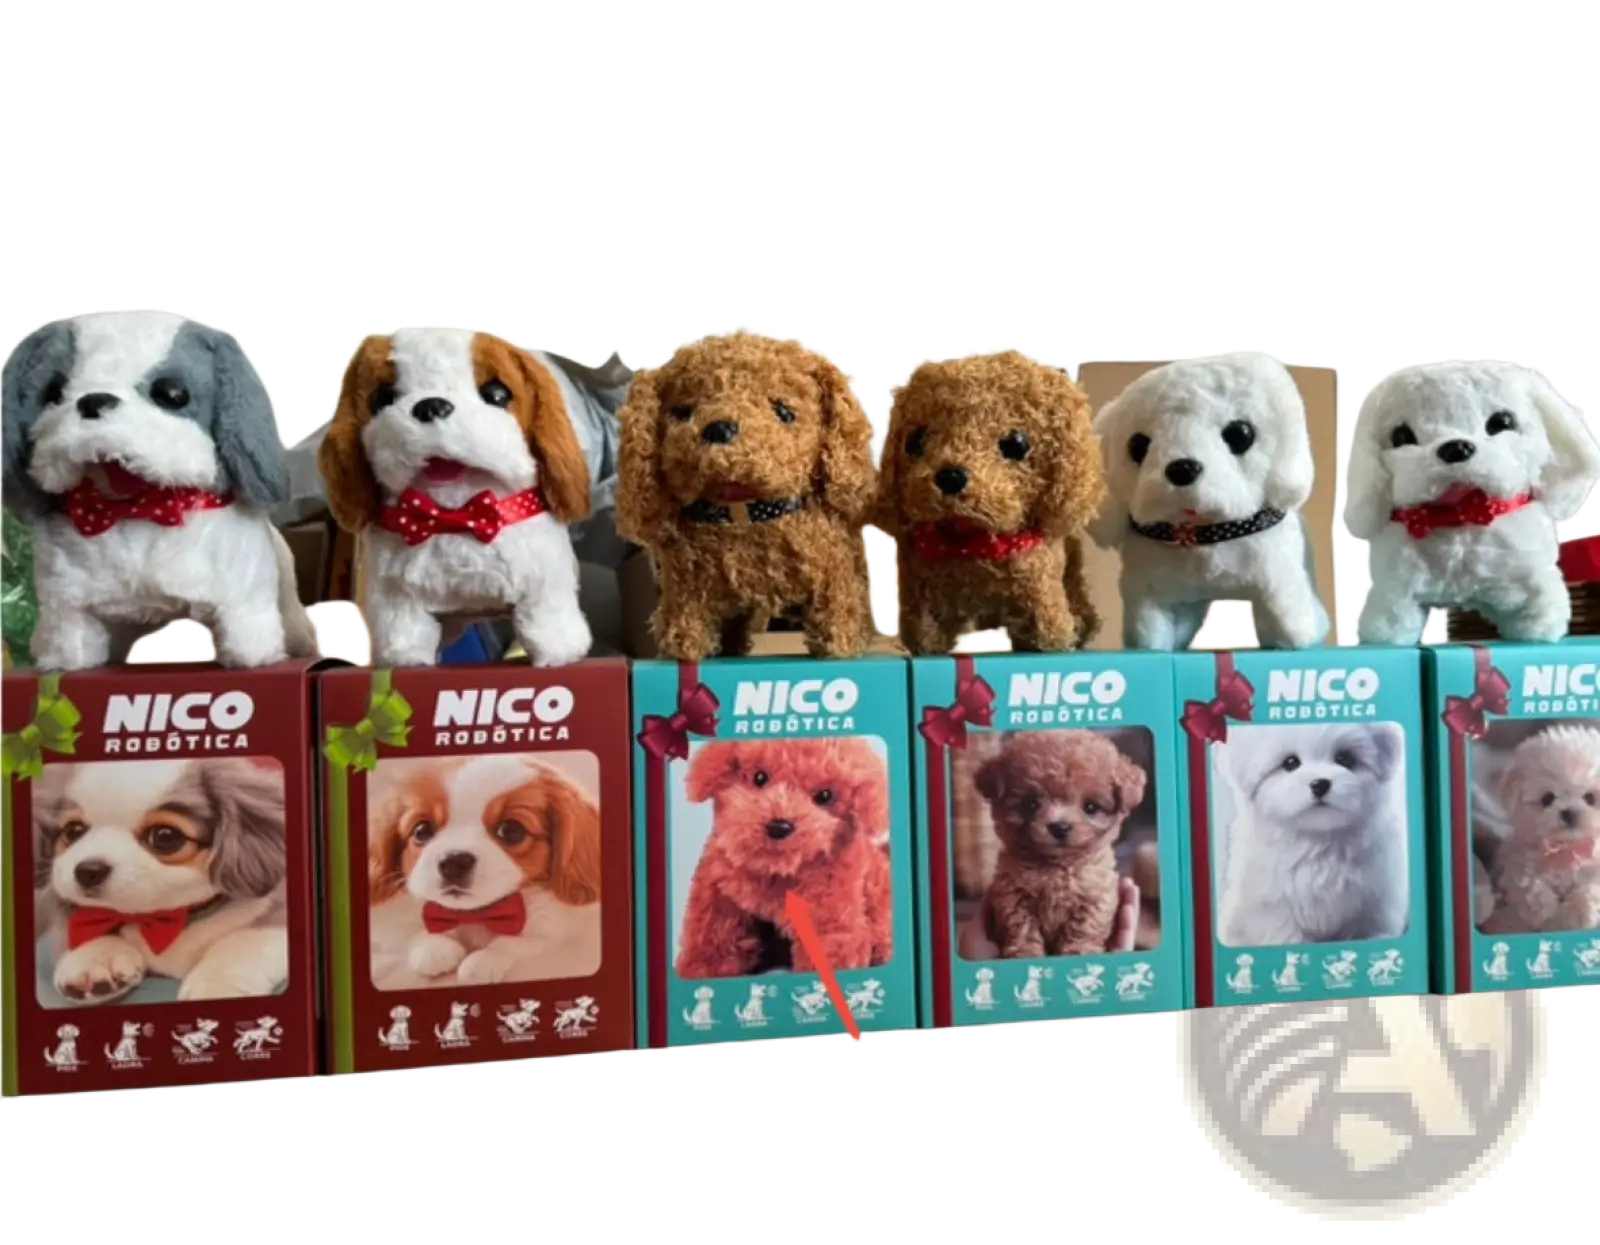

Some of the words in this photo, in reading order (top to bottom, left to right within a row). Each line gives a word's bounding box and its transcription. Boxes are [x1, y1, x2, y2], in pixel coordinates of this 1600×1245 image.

[1009, 670, 1126, 706] NICO
[1268, 668, 1379, 702] NICO
[1523, 664, 1600, 696] NIC
[104, 691, 254, 732] NICO
[434, 686, 574, 726] NICO
[734, 679, 858, 715] NICO
[1268, 704, 1376, 721] ROBÓTICA
[736, 715, 854, 734] ROBÓTICA
[1011, 706, 1123, 724] ROBÓTICA
[105, 730, 248, 752] ROBÓTICA
[436, 723, 569, 745] ROBÓTICA
